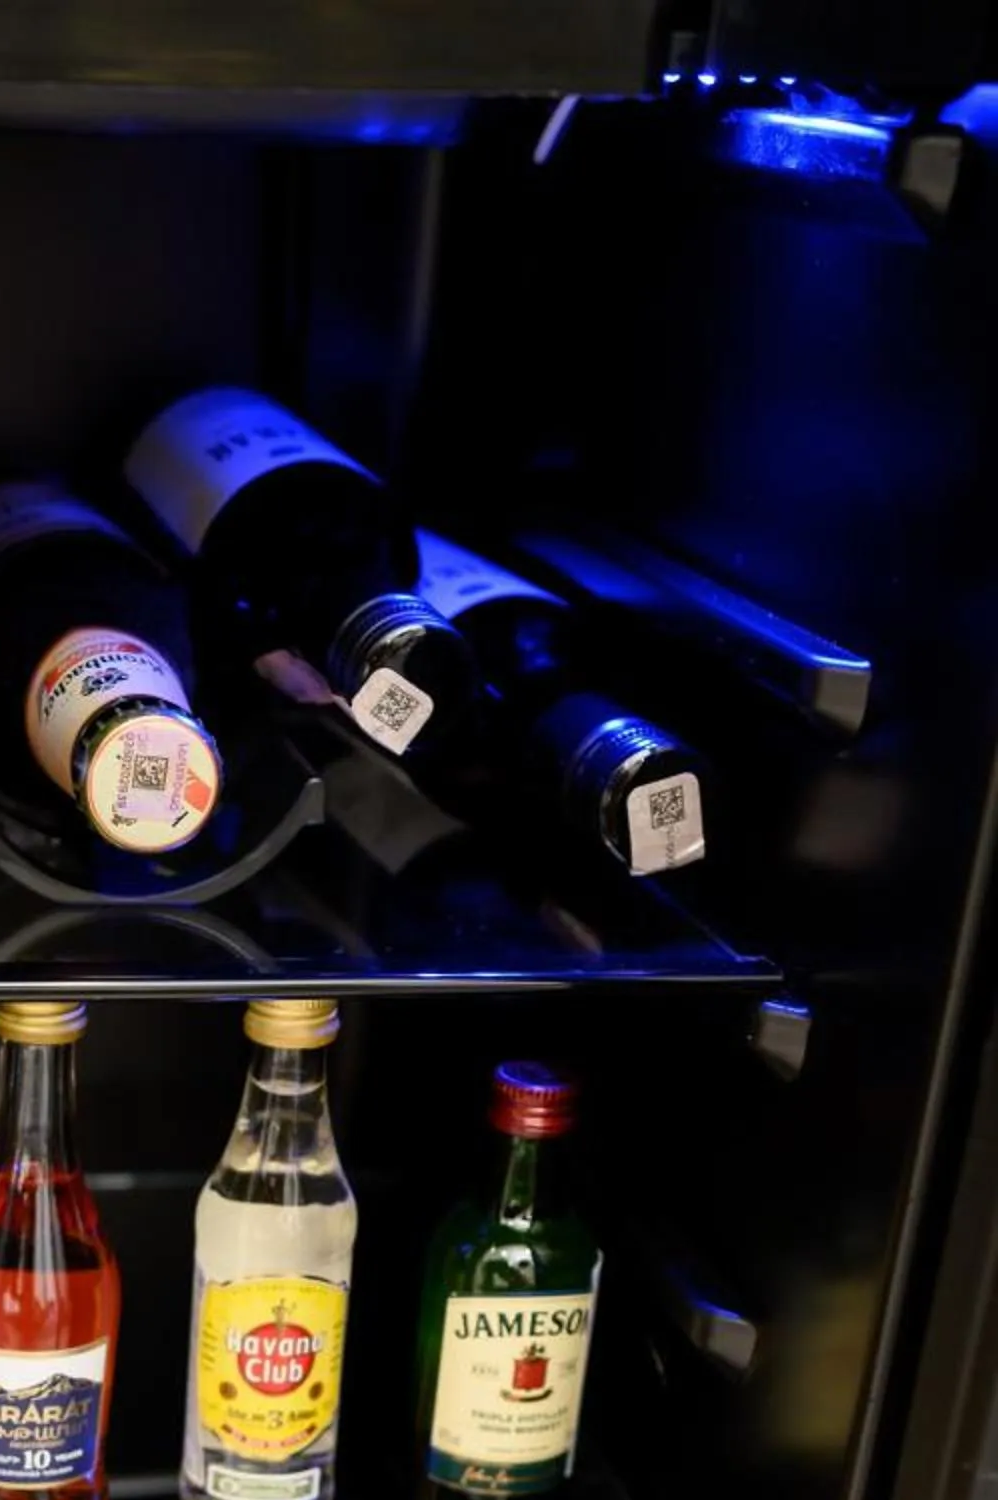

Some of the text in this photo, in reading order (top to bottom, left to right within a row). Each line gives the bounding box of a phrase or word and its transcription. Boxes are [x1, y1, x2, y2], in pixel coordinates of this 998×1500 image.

[225, 1328, 324, 1357] Havana
[245, 1358, 303, 1384] Club
[23, 1450, 51, 1469] 10
